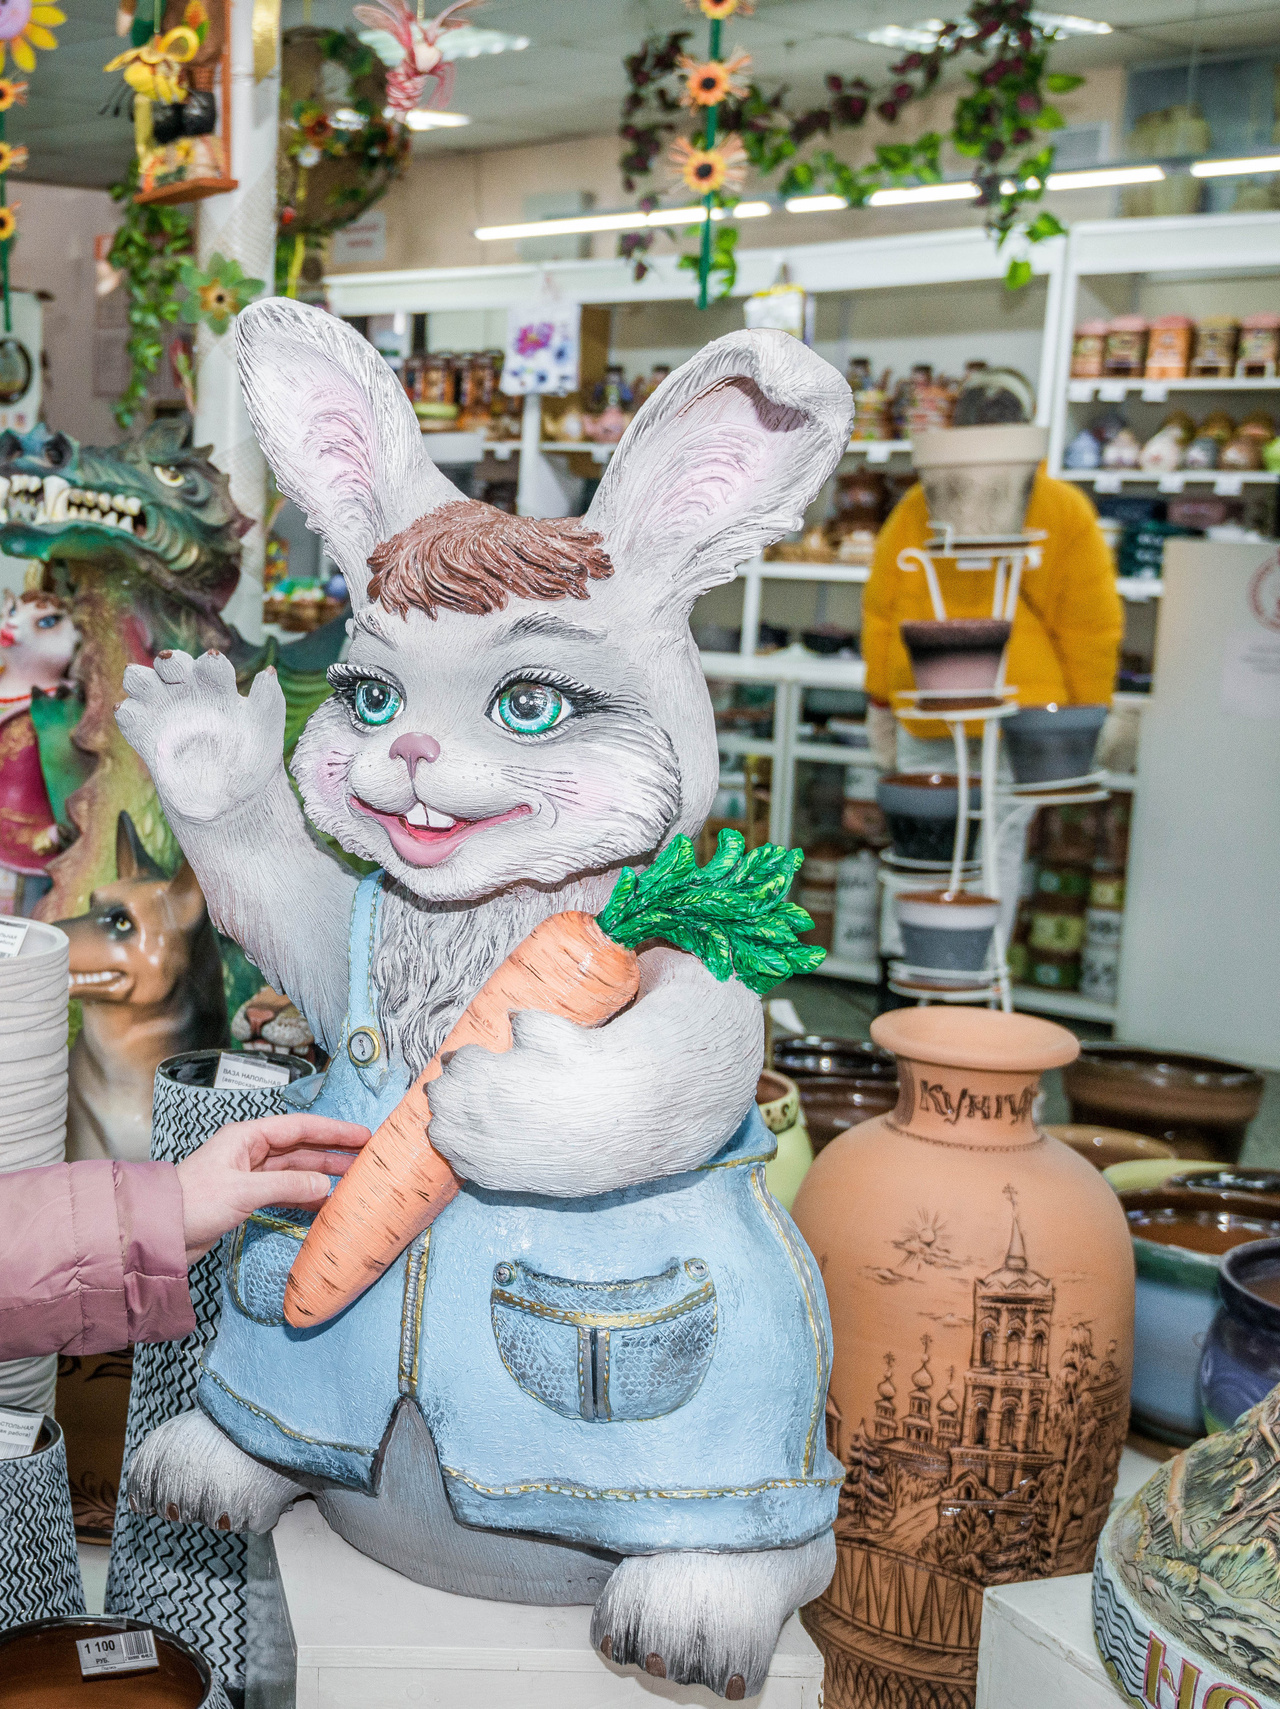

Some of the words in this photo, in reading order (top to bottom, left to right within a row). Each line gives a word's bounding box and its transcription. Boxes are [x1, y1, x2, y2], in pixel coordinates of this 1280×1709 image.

[223, 1068, 240, 1077] ВАЗА
[241, 1073, 281, 1086] НАПОЛЬНАЯ
[7, 1429, 31, 1438] работа)
[84, 1643, 91, 1654] 1
[95, 1639, 115, 1652] 100
